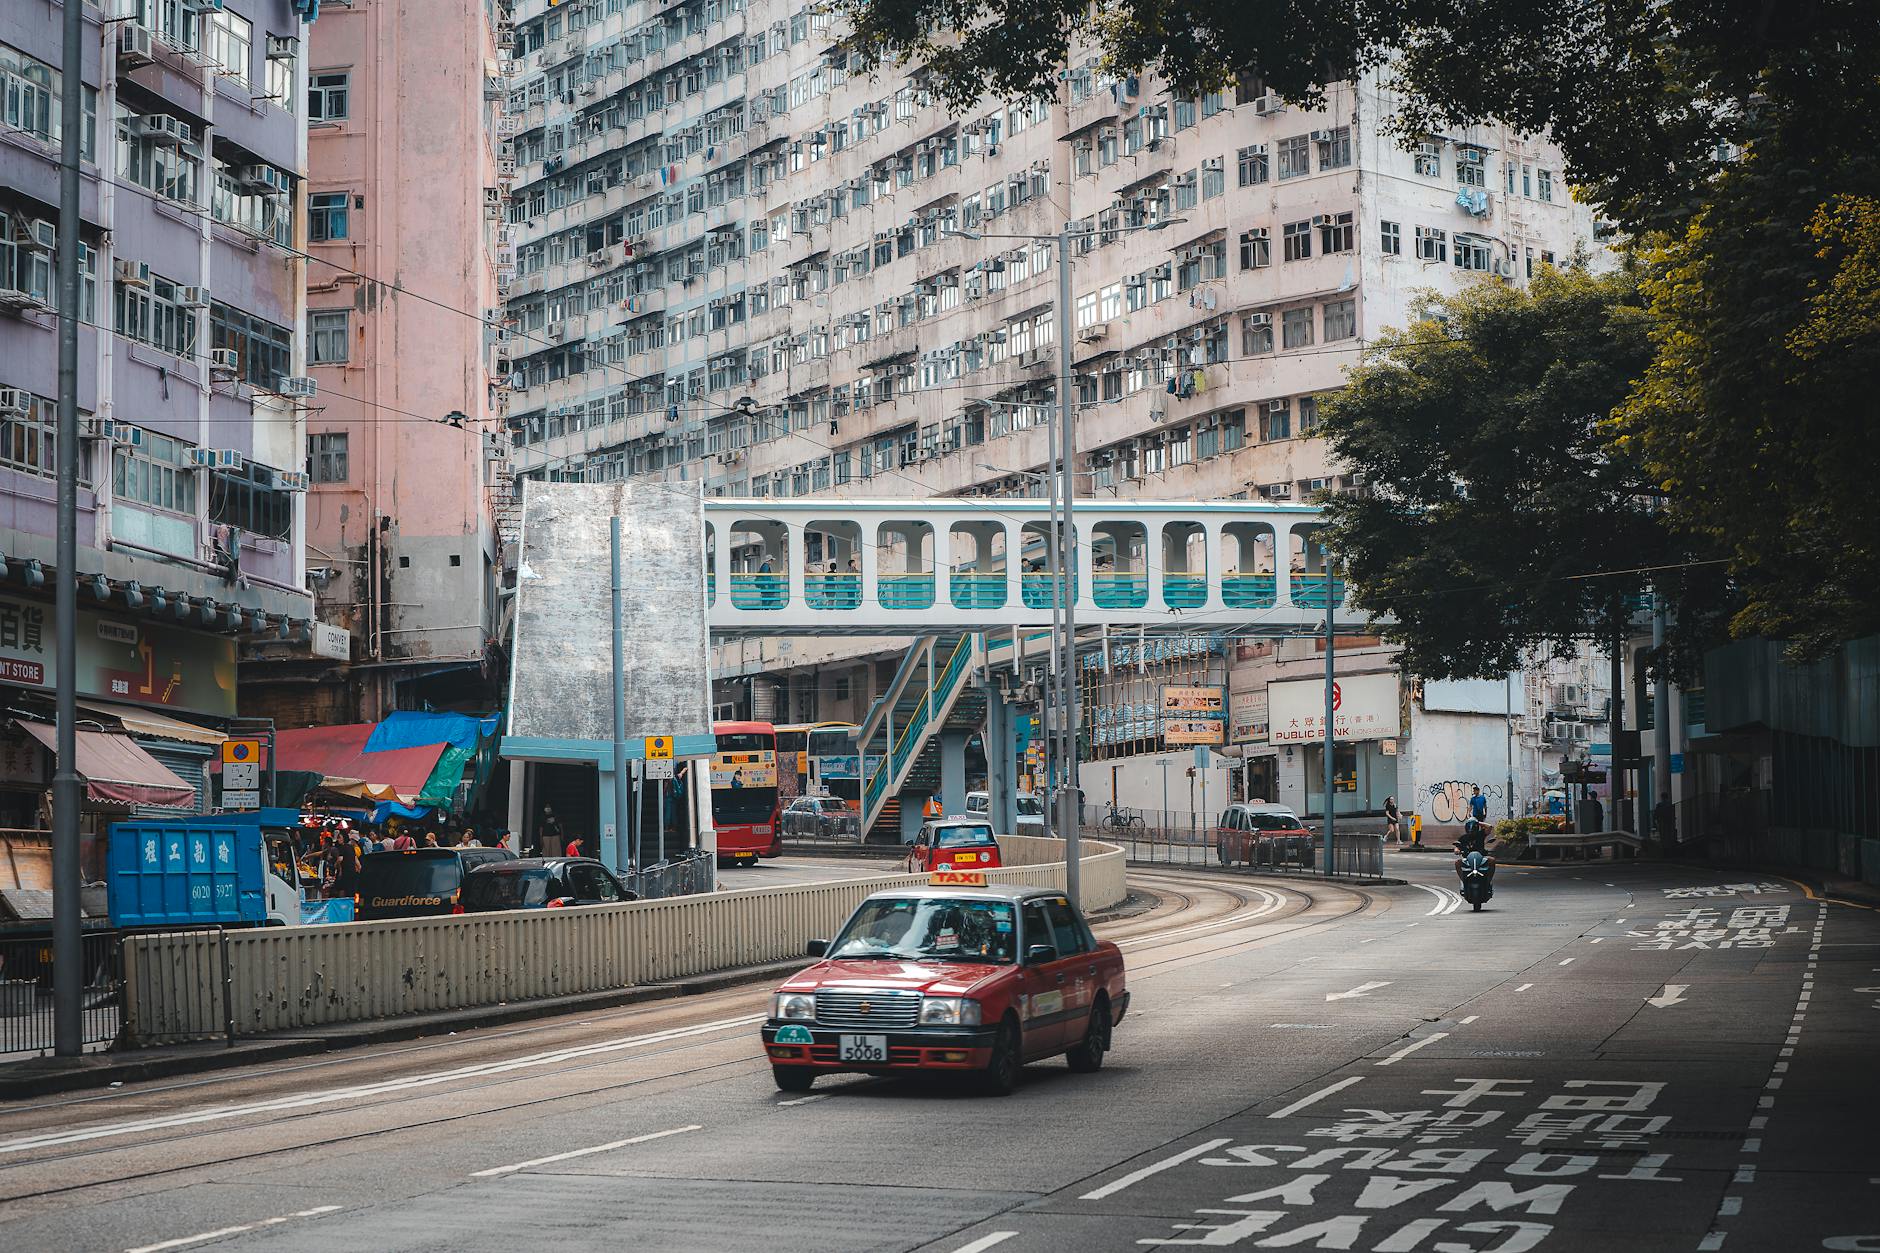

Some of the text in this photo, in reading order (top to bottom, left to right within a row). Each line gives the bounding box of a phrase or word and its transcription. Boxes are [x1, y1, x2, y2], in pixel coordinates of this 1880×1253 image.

[12, 664, 39, 680] STORE
[1276, 730, 1315, 740] PUBLIC
[1318, 728, 1349, 737] BNK
[246, 765, 252, 773] 7
[246, 779, 252, 787] 7
[935, 872, 980, 883] TAXI
[192, 884, 233, 899] 6020 5927
[372, 895, 441, 907] Guardforce
[1644, 934, 1772, 942] WAY
[1631, 940, 1777, 950] GIVE
[790, 1030, 797, 1038] 4
[854, 1036, 872, 1048] UL
[845, 1048, 882, 1060] 5008
[1421, 1079, 1668, 1111] 巴士
[1304, 1109, 1672, 1148] 請讓
[1199, 1145, 1683, 1181] TO BUS
[1224, 1174, 1577, 1214] WAY
[1136, 1209, 1554, 1253] GIVE
